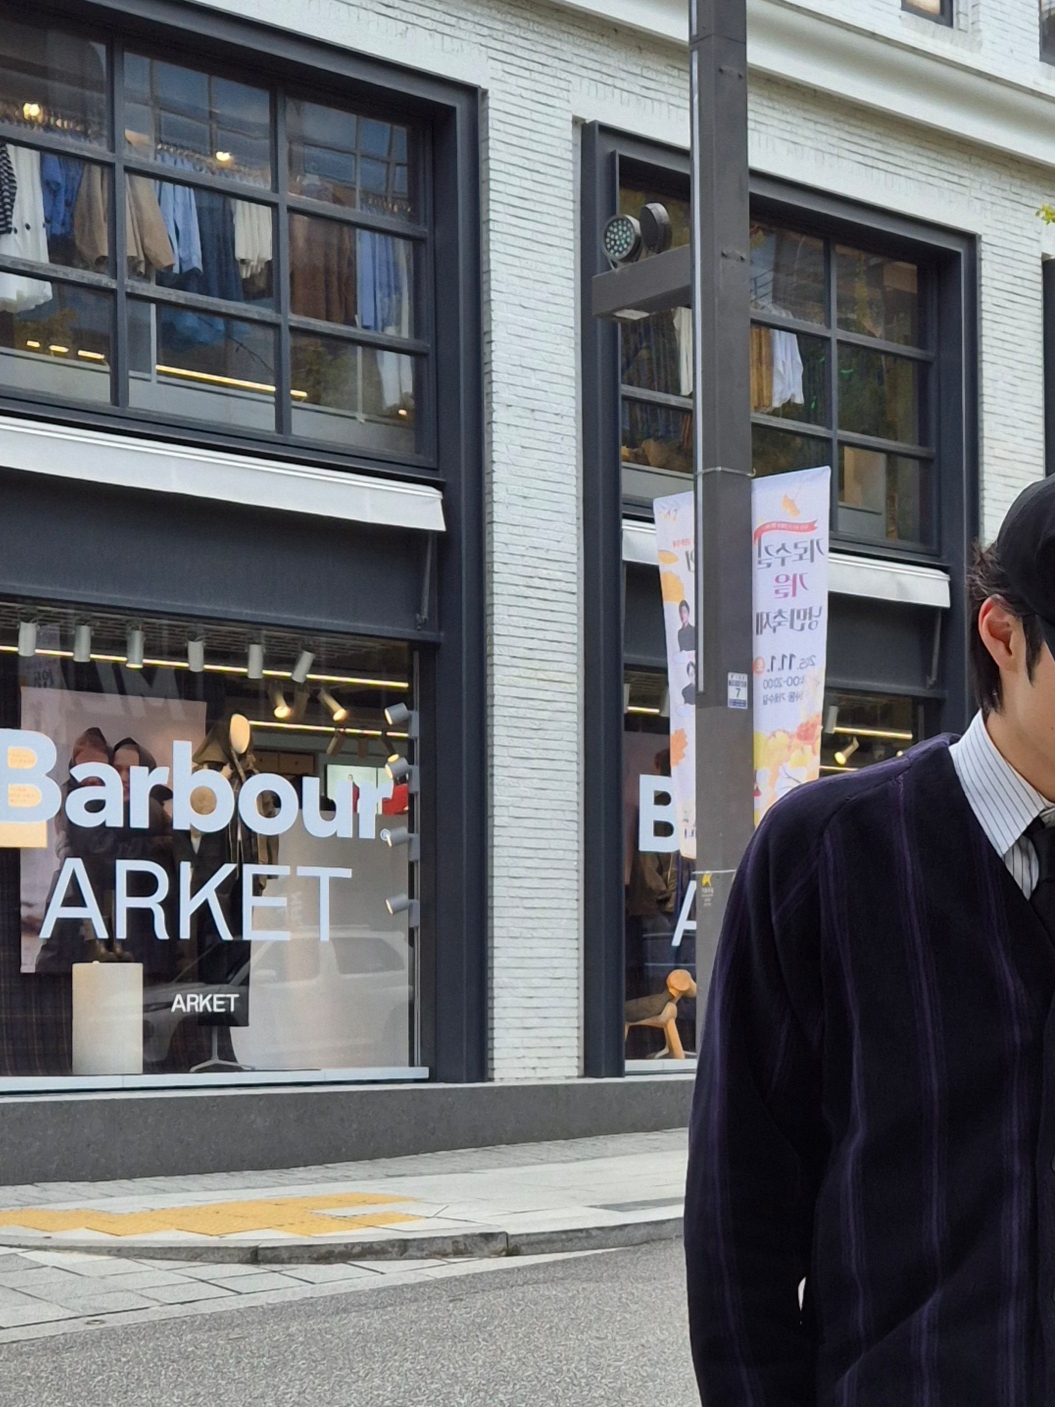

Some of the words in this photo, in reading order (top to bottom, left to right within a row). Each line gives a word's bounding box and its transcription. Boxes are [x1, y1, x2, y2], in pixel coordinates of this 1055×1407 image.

[734, 687, 742, 698] 7
[39, 857, 353, 942] ARKET
[171, 993, 240, 1013] ARKET
